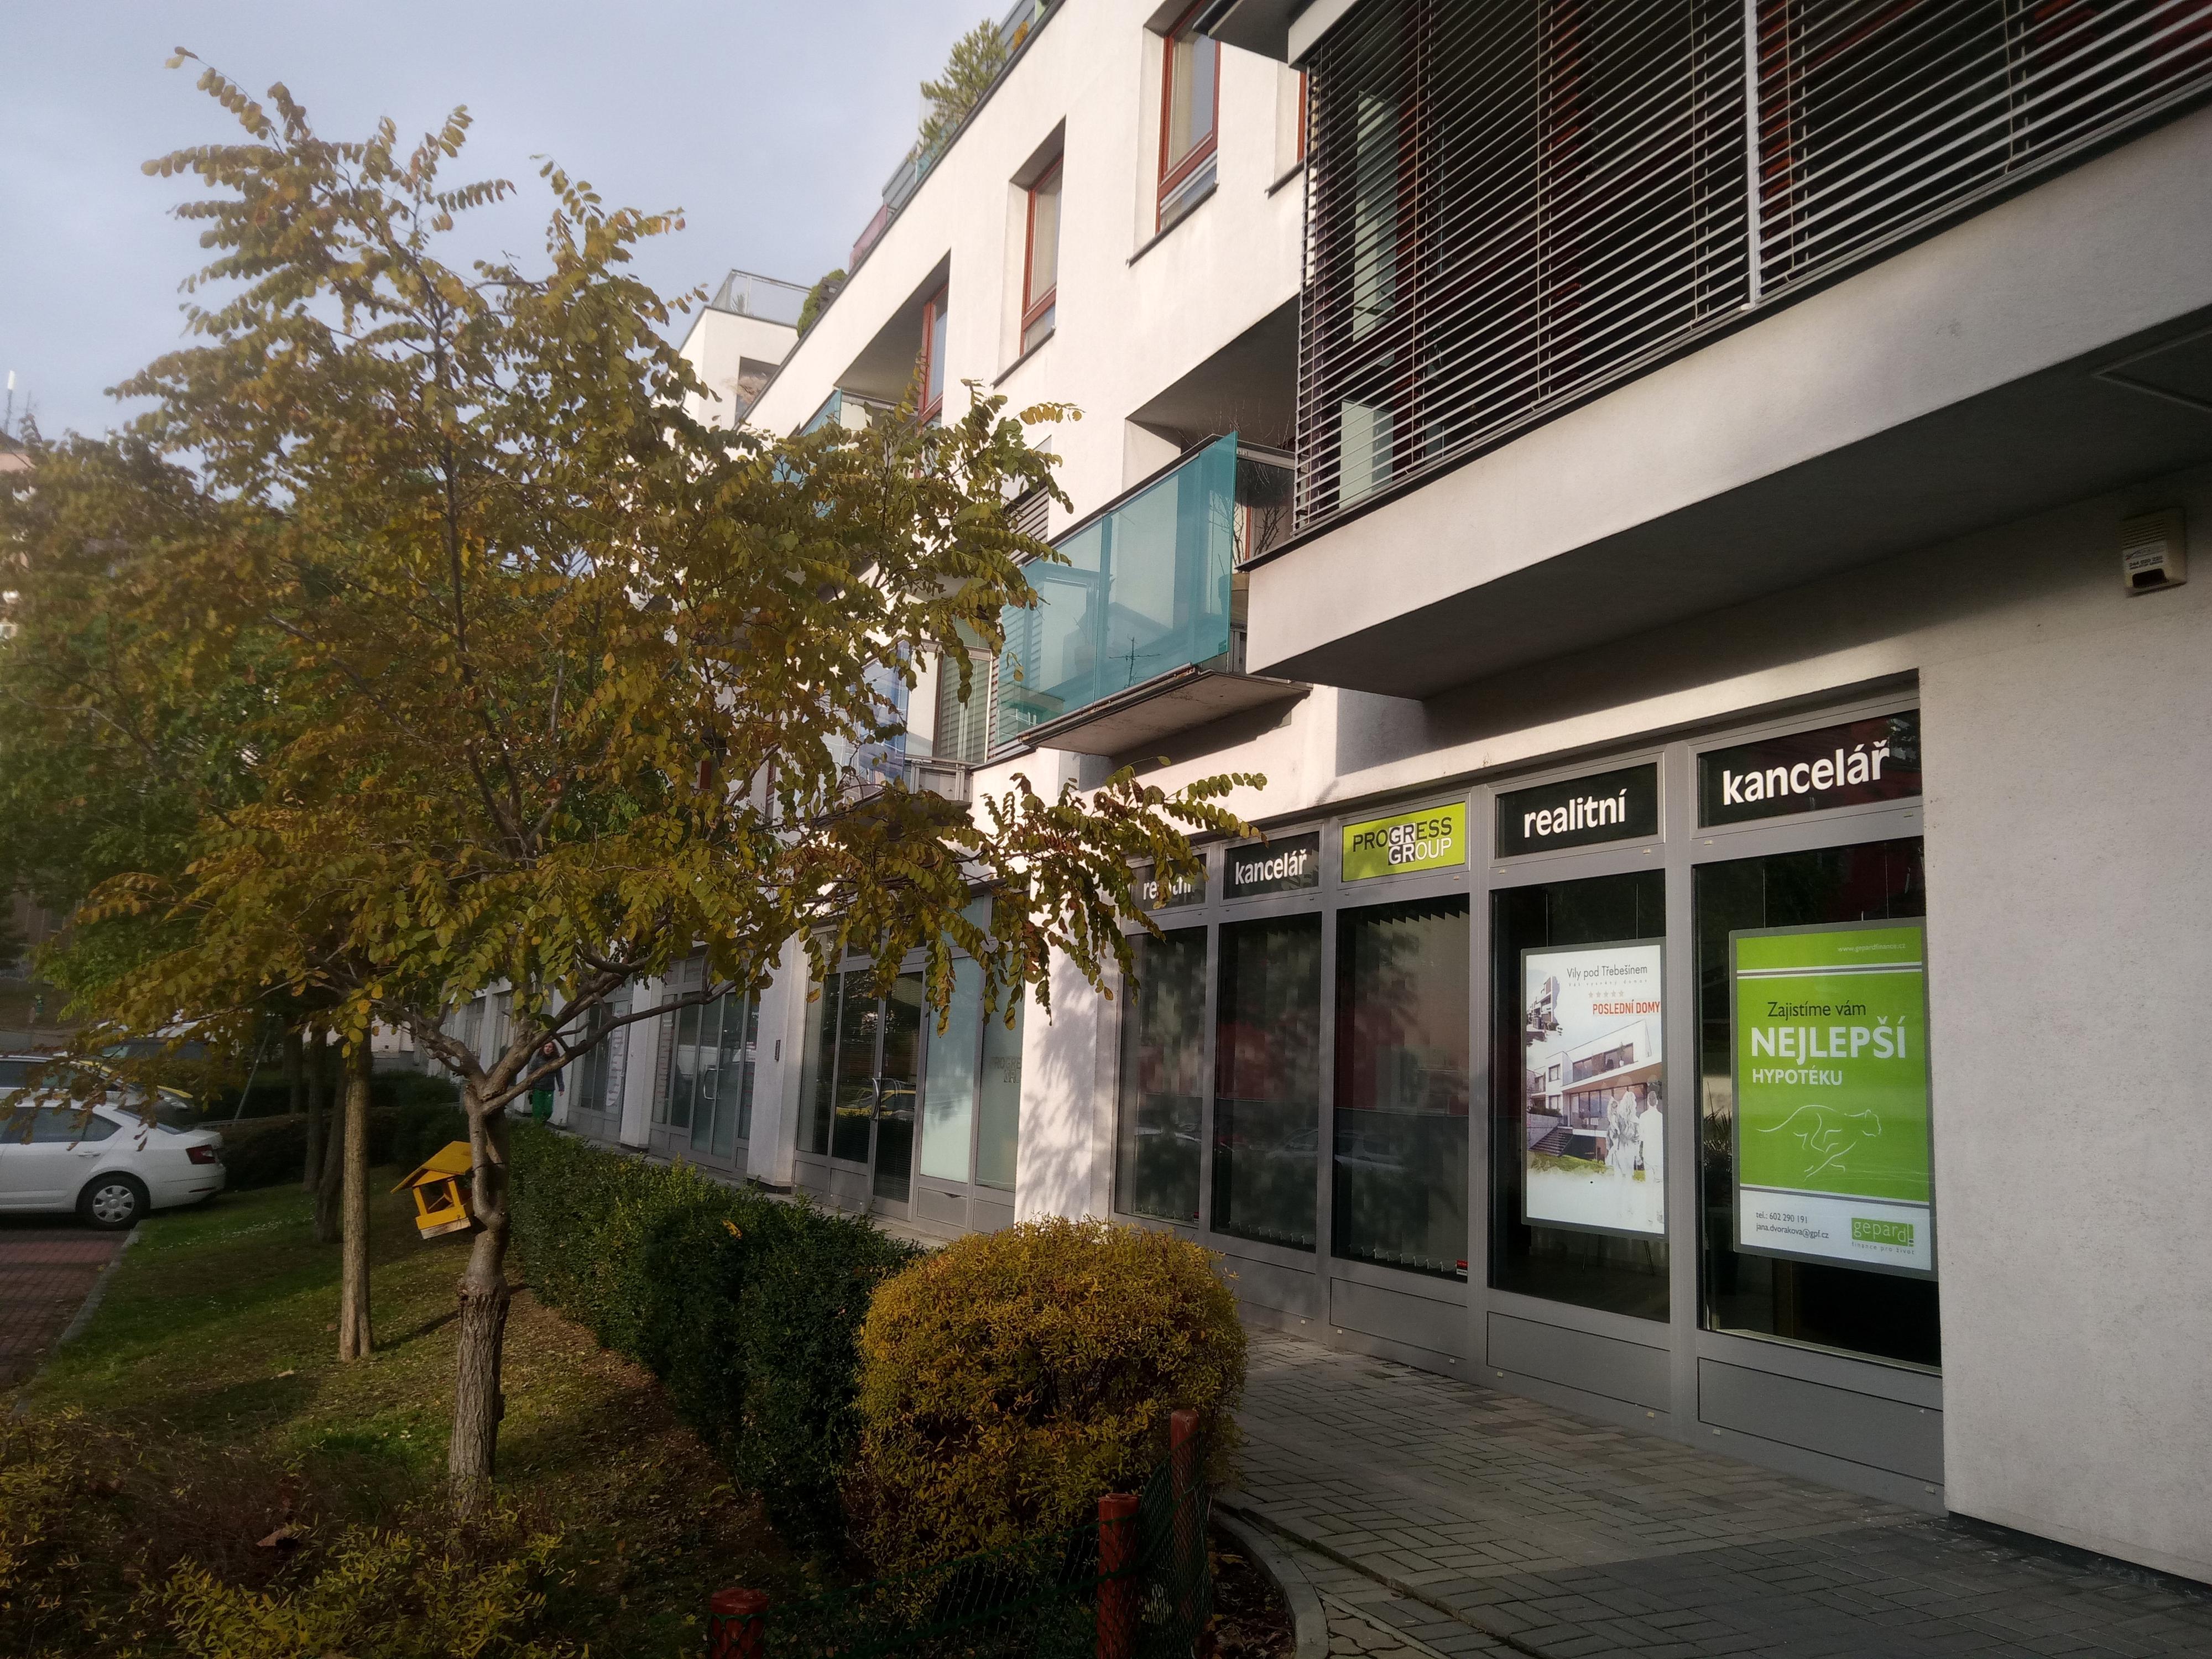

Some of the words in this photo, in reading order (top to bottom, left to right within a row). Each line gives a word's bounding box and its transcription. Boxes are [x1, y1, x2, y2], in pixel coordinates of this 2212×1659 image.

[1524, 788, 1627, 838] realitní
[1723, 739, 1890, 806] kancelář
[1353, 817, 1452, 852] PROGRESS
[1389, 837, 1452, 865] GROUP
[1235, 849, 1307, 885] kancelář
[1567, 967, 1582, 981] Vily
[1584, 966, 1599, 980] pod
[1601, 964, 1648, 976] Třebešínem
[1593, 999, 1634, 1015] POSLEDNÍ
[1636, 1001, 1660, 1014] DOMY
[1767, 1001, 1831, 1020] Zajistíme
[1835, 1000, 1866, 1016] vám
[1751, 1016, 1906, 1065] NEJLEPŠÍ
[1752, 1066, 1843, 1086] HYPOTÉKU
[1783, 1213, 1794, 1222] 290
[1797, 1215, 1807, 1223] 191
[1756, 1223, 1829, 1239] jana.dvorakova@gpf.cz
